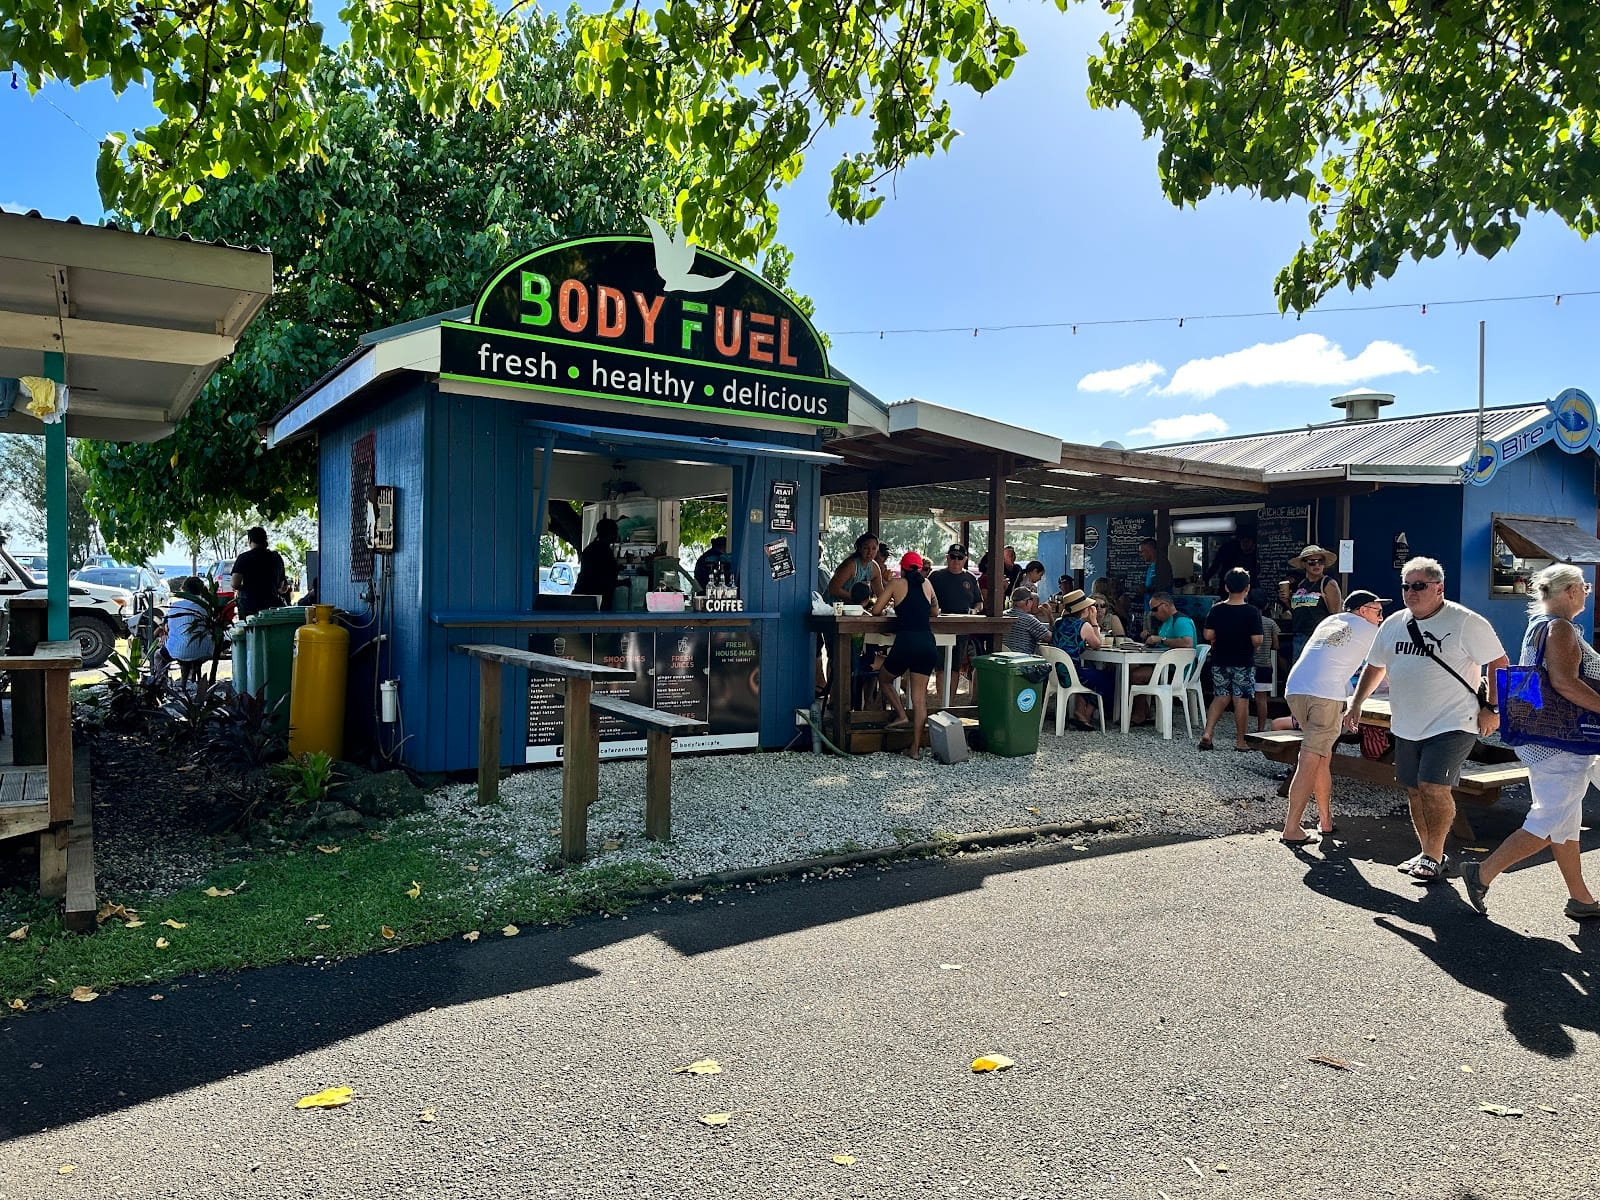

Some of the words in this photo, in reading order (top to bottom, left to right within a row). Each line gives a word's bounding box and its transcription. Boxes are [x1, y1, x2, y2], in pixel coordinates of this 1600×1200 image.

[520, 270, 665, 345] BODY
[681, 300, 798, 367] FUEL
[477, 343, 557, 380] fresh
[591, 359, 695, 403] healthy
[723, 379, 828, 416] delicious
[1501, 426, 1545, 461] Bite
[706, 600, 744, 612] COFFEE
[1395, 641, 1435, 656] PUMA
[603, 655, 646, 663] SMOOTHIES
[670, 661, 695, 669] JUICES
